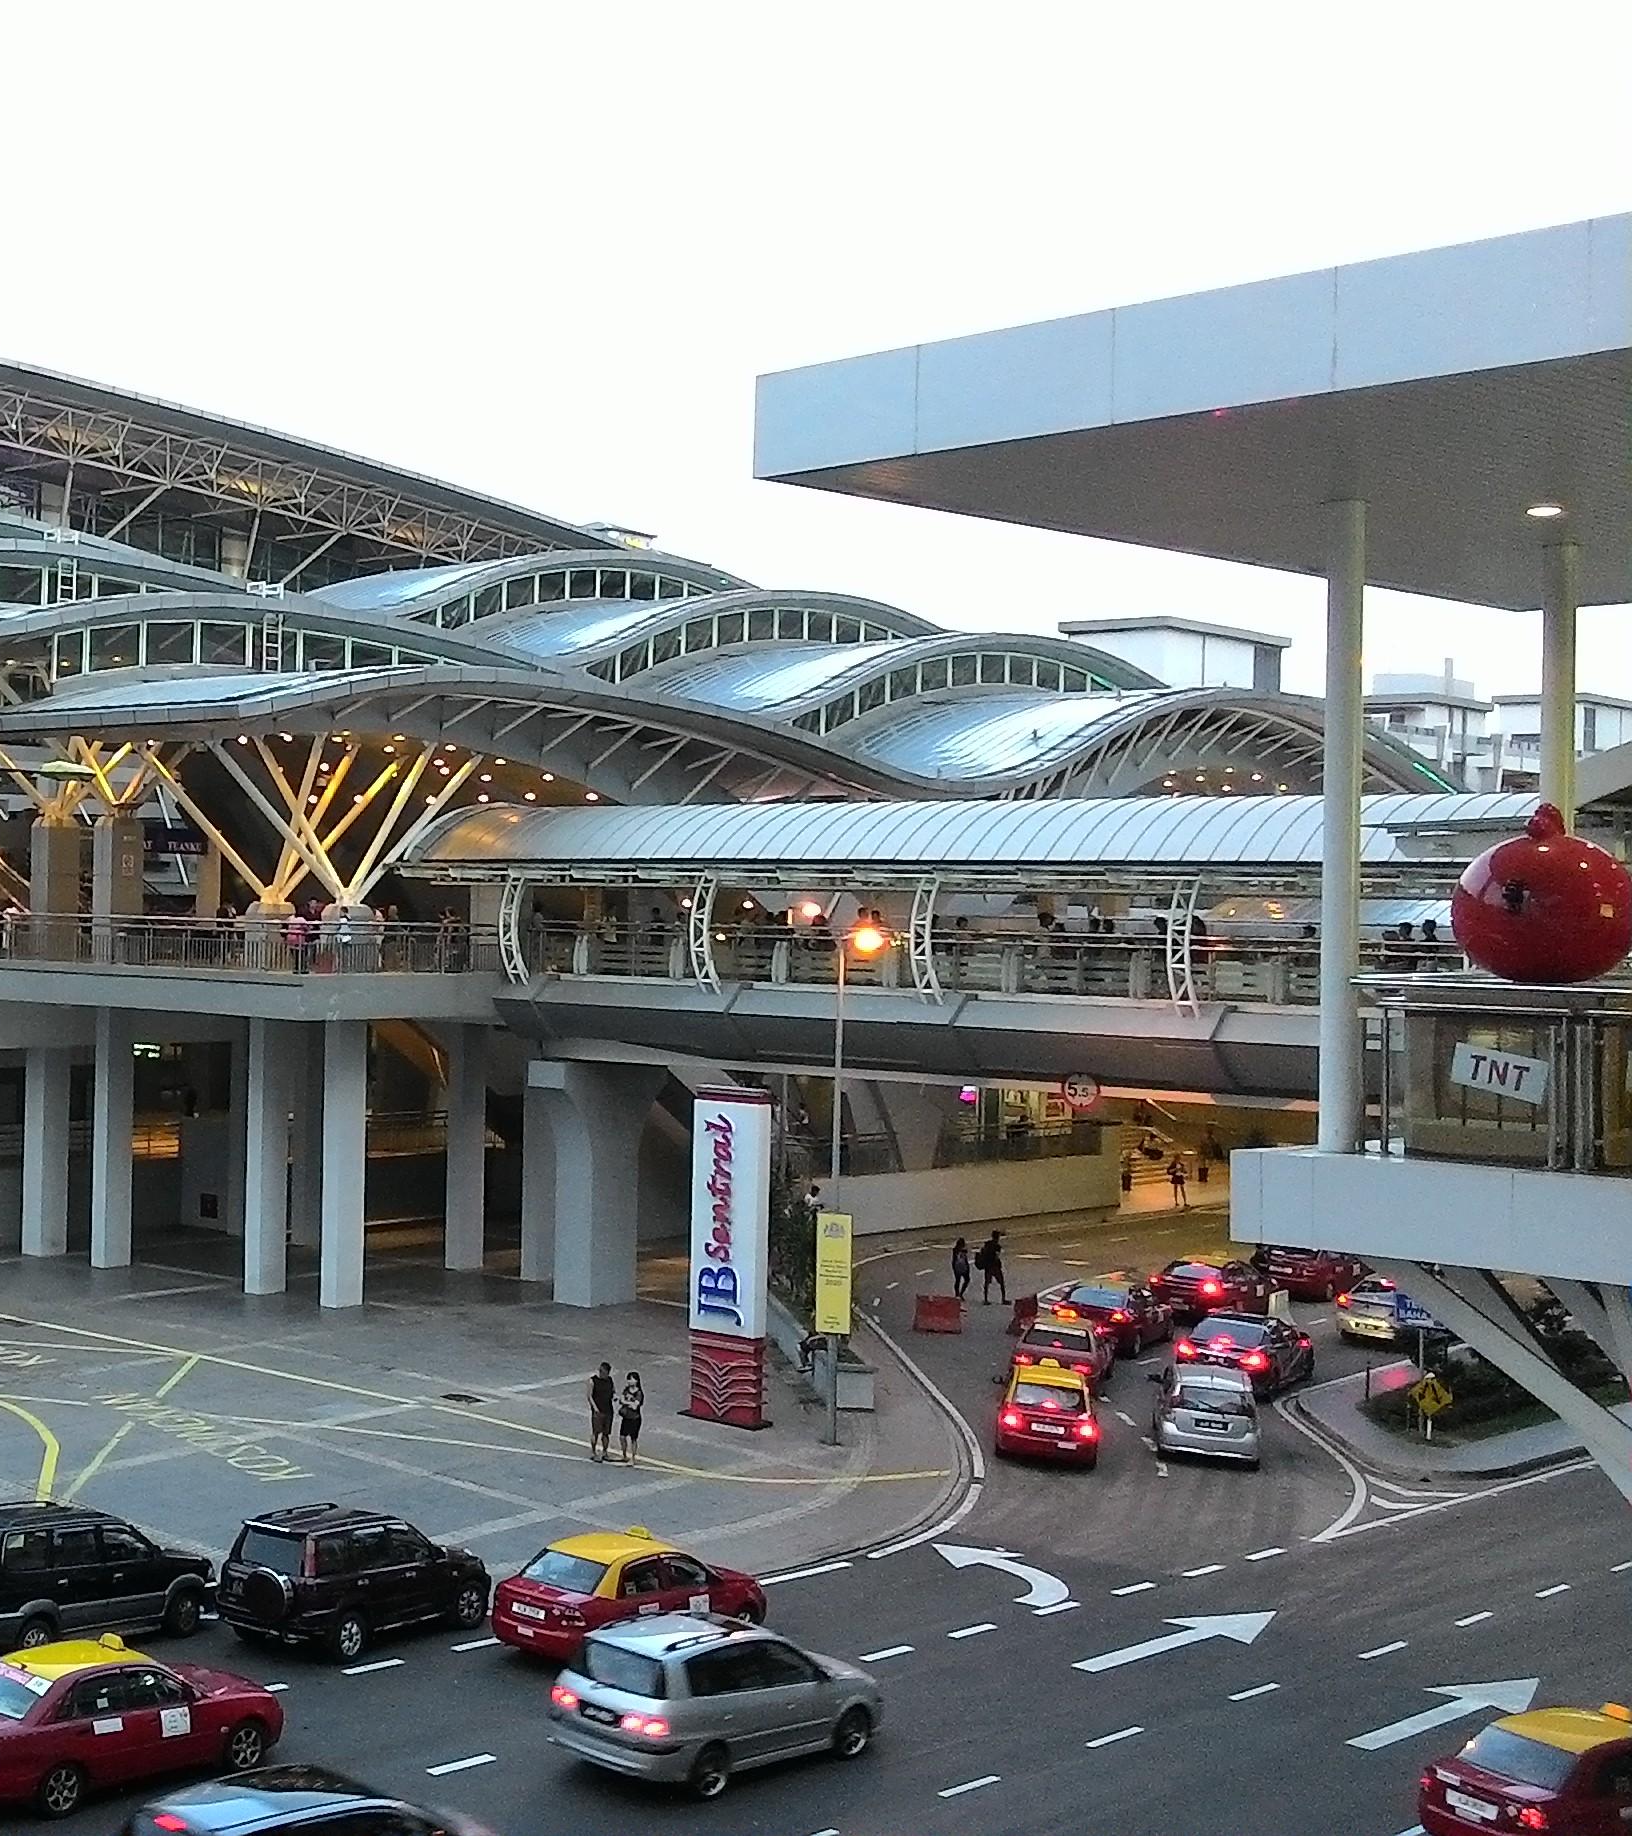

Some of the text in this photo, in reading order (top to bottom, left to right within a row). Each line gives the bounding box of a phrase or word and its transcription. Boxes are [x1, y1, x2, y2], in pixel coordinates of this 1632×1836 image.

[1470, 1053, 1531, 1092] TNT
[697, 1113, 745, 1328] JB Sentral
